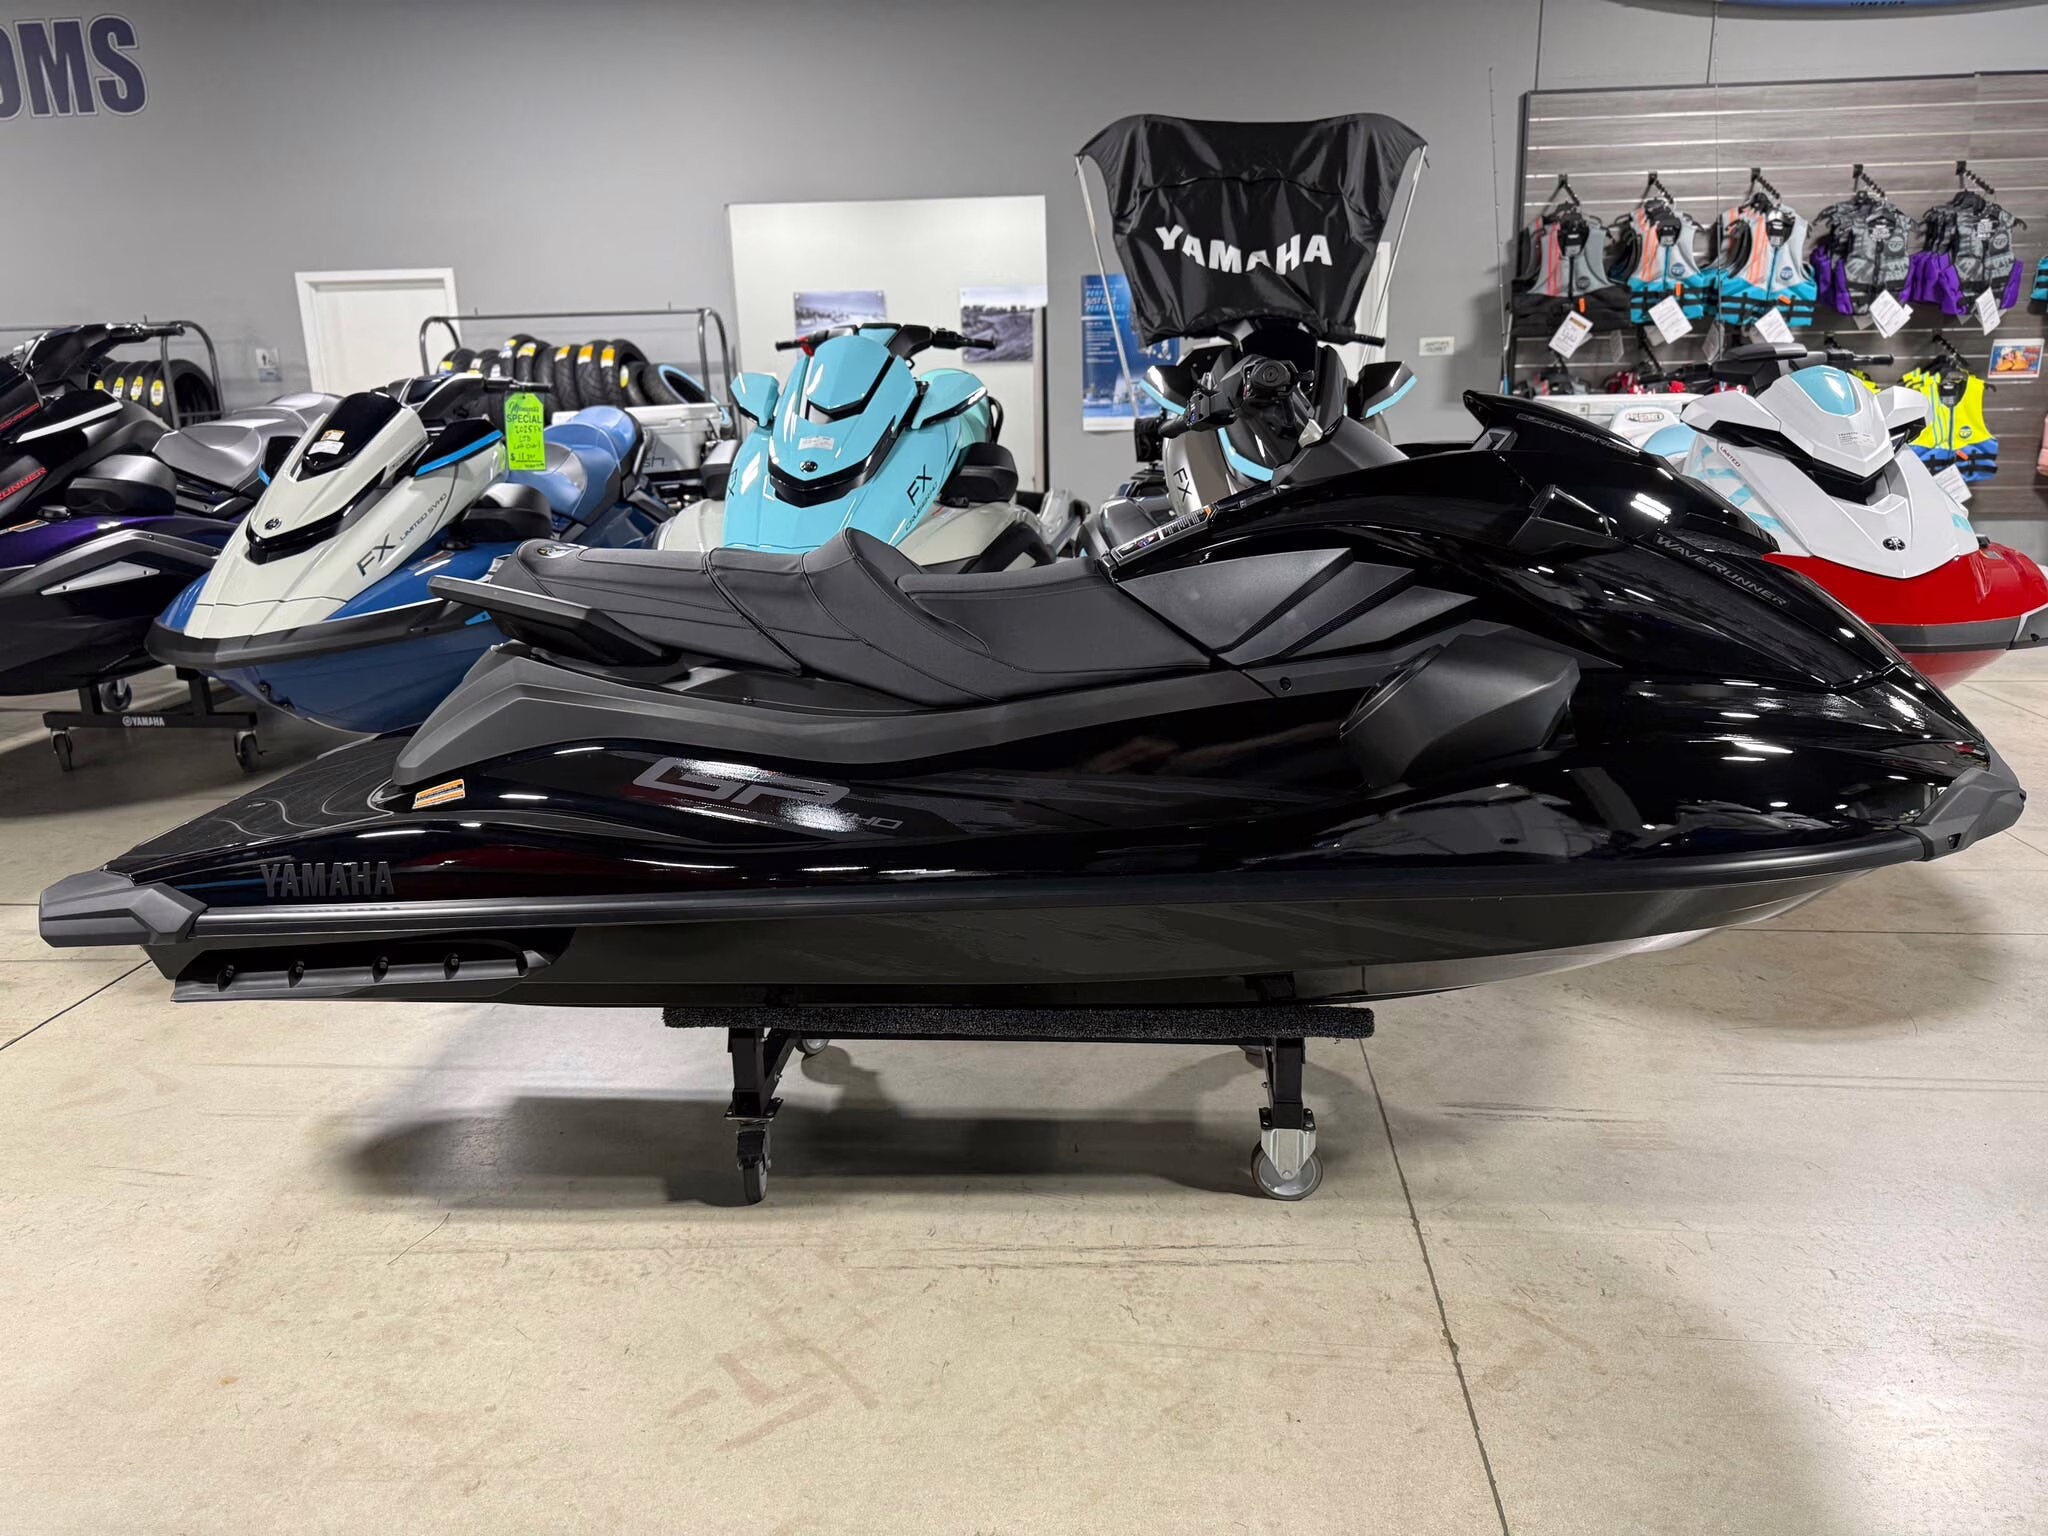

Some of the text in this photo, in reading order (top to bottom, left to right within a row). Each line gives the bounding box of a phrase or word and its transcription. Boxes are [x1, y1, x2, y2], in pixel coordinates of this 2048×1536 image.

[1155, 224, 1333, 275] YAMAHA
[506, 414, 542, 424] SPECIAL
[1718, 445, 1742, 468] LIMITED
[906, 463, 933, 507] FX
[1173, 467, 1193, 503] FX
[399, 492, 448, 541] LIMITED SVHO
[356, 533, 397, 577] FX
[1656, 534, 1788, 606] WAVERUNNER
[132, 716, 165, 727] YAMAHA
[632, 756, 851, 806] GP
[259, 861, 396, 898] YAMAHA
